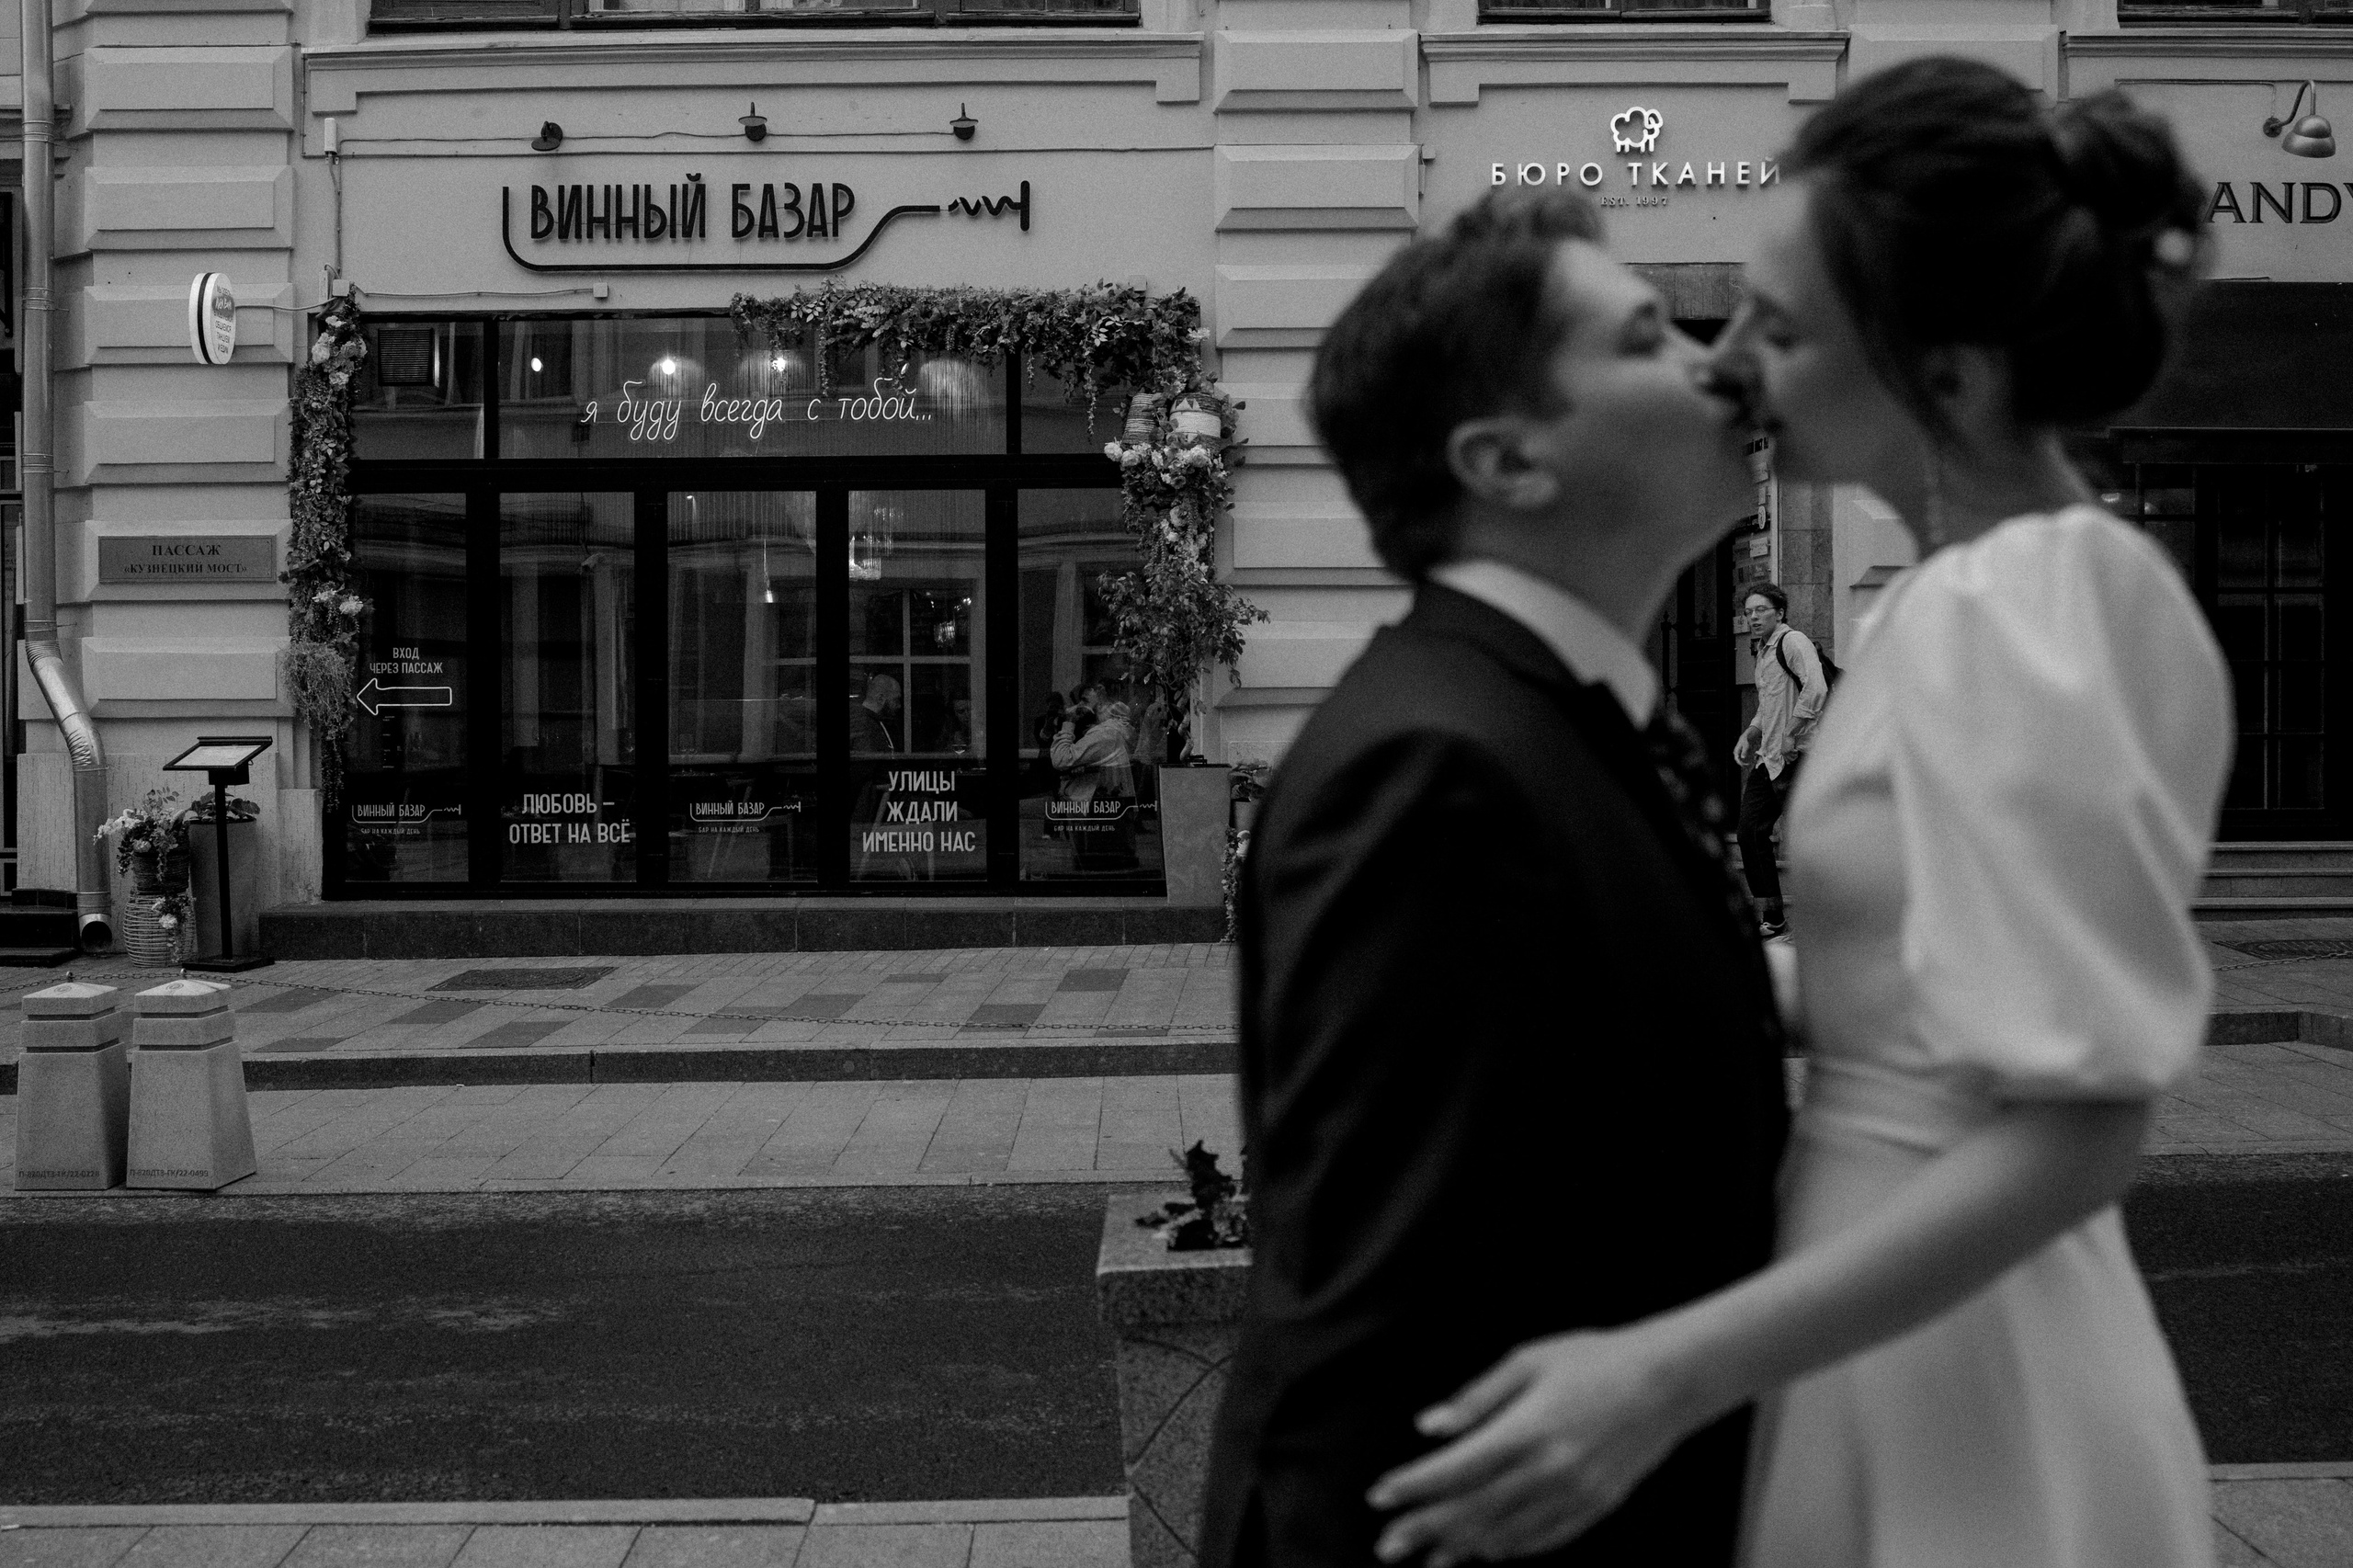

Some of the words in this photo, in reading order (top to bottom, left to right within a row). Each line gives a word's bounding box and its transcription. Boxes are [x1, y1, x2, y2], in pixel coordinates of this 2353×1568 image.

[1491, 162, 1604, 186] БЮРО
[530, 173, 707, 240] ВИННЫЙ
[732, 183, 856, 239] БАЗАР
[1600, 196, 1630, 205] EST.
[1636, 196, 1669, 205] 1997
[2204, 182, 2353, 223] AND
[580, 400, 597, 423] я
[617, 381, 682, 440] буду
[700, 382, 783, 438] всегда
[808, 398, 822, 420] с
[837, 378, 932, 421] тобой...
[152, 544, 222, 556] ПАССАЖ
[124, 562, 204, 574] «КУЗНЕЦКИЙ
[206, 563, 247, 574] МОСТ»
[392, 647, 420, 660] ВХОД
[369, 663, 399, 674] ЧЕРЕЗ
[402, 662, 443, 674] ПАССАЖ
[888, 771, 956, 794] УЛИЦЫ
[358, 802, 395, 817] ВИННЫЙ
[399, 803, 426, 817] БАЗАР
[521, 793, 597, 814] ЛЮБОВЬ
[696, 800, 733, 815] ВИННЫЙ
[737, 801, 765, 815] БАЗАР
[1051, 800, 1089, 814] ВИННЫЙ
[1093, 801, 1121, 813] БАЗАР
[886, 801, 958, 824] ЖДАЛИ
[509, 824, 562, 844] ОТВЕТ
[568, 824, 591, 843] НА
[597, 819, 631, 844] ВСЁ
[719, 825, 745, 834] КАЖДЫЙ
[1074, 824, 1100, 832] КАЖДЫЙ
[862, 832, 934, 853] ИМЕННО
[940, 832, 976, 852] НАС
